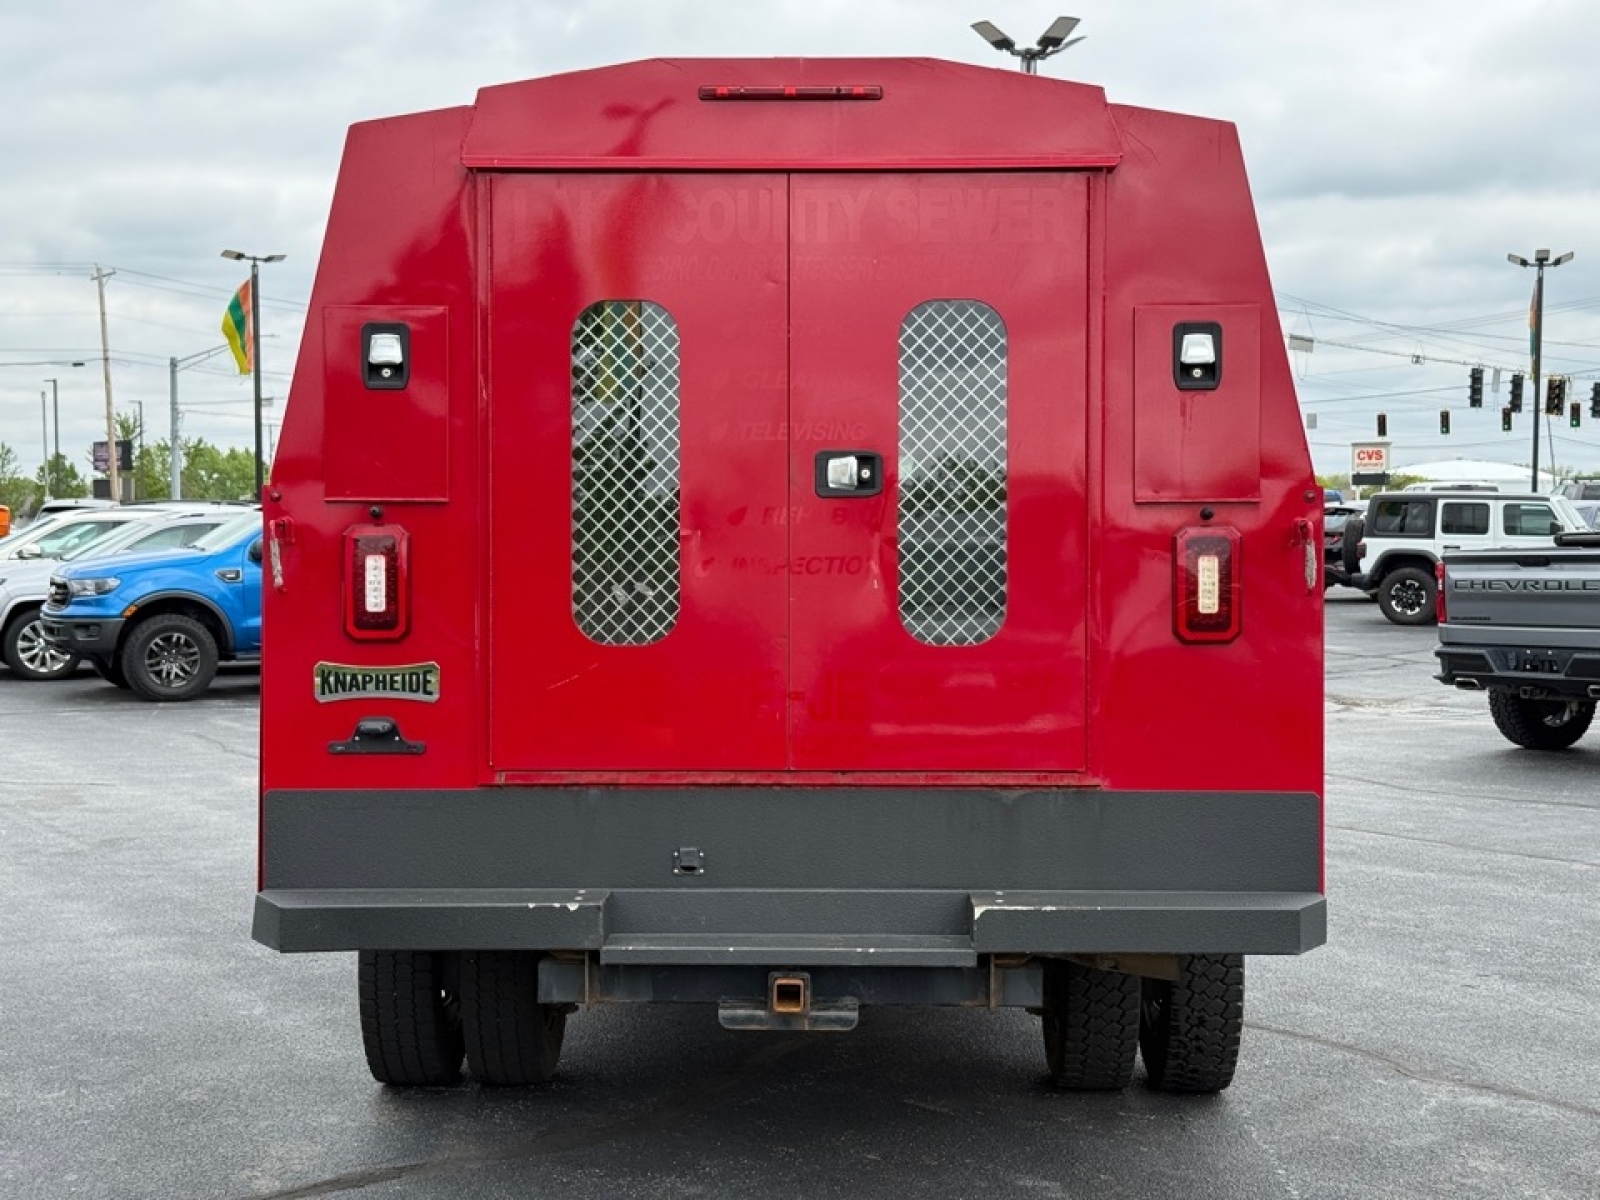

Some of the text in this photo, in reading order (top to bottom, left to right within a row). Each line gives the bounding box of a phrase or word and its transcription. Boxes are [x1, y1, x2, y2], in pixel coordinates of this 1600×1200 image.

[886, 187, 1066, 242] SEWER
[739, 421, 867, 441] TELEVISING
[1358, 449, 1383, 461] CVS
[319, 669, 434, 696] KNAPHEIDE
